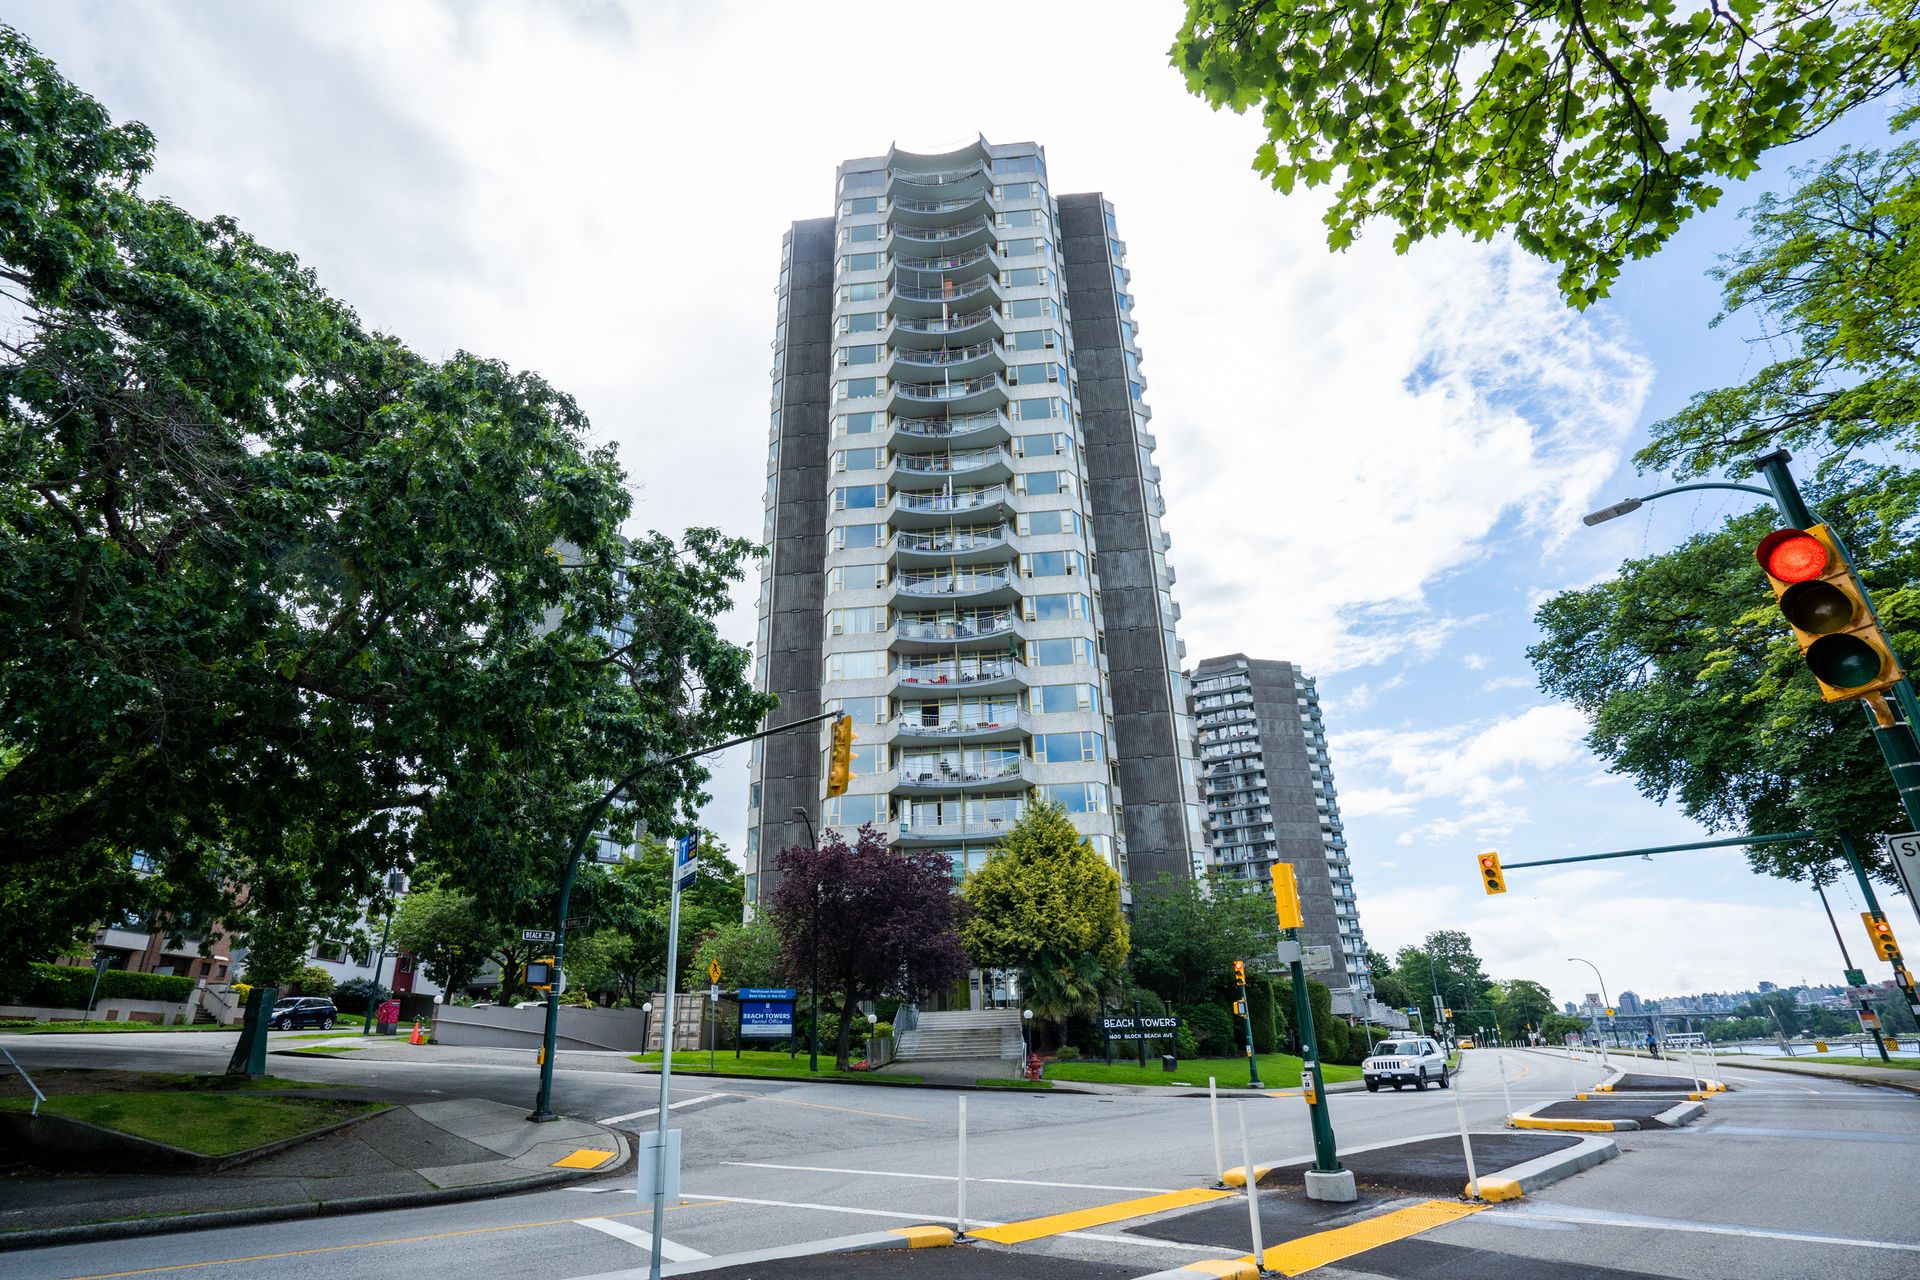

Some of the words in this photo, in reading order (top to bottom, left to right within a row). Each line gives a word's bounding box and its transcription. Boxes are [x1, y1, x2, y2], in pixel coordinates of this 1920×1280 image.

[526, 931, 542, 939] BEACH
[1104, 1018, 1134, 1028] BEACH
[1140, 1018, 1177, 1027] TOWERS
